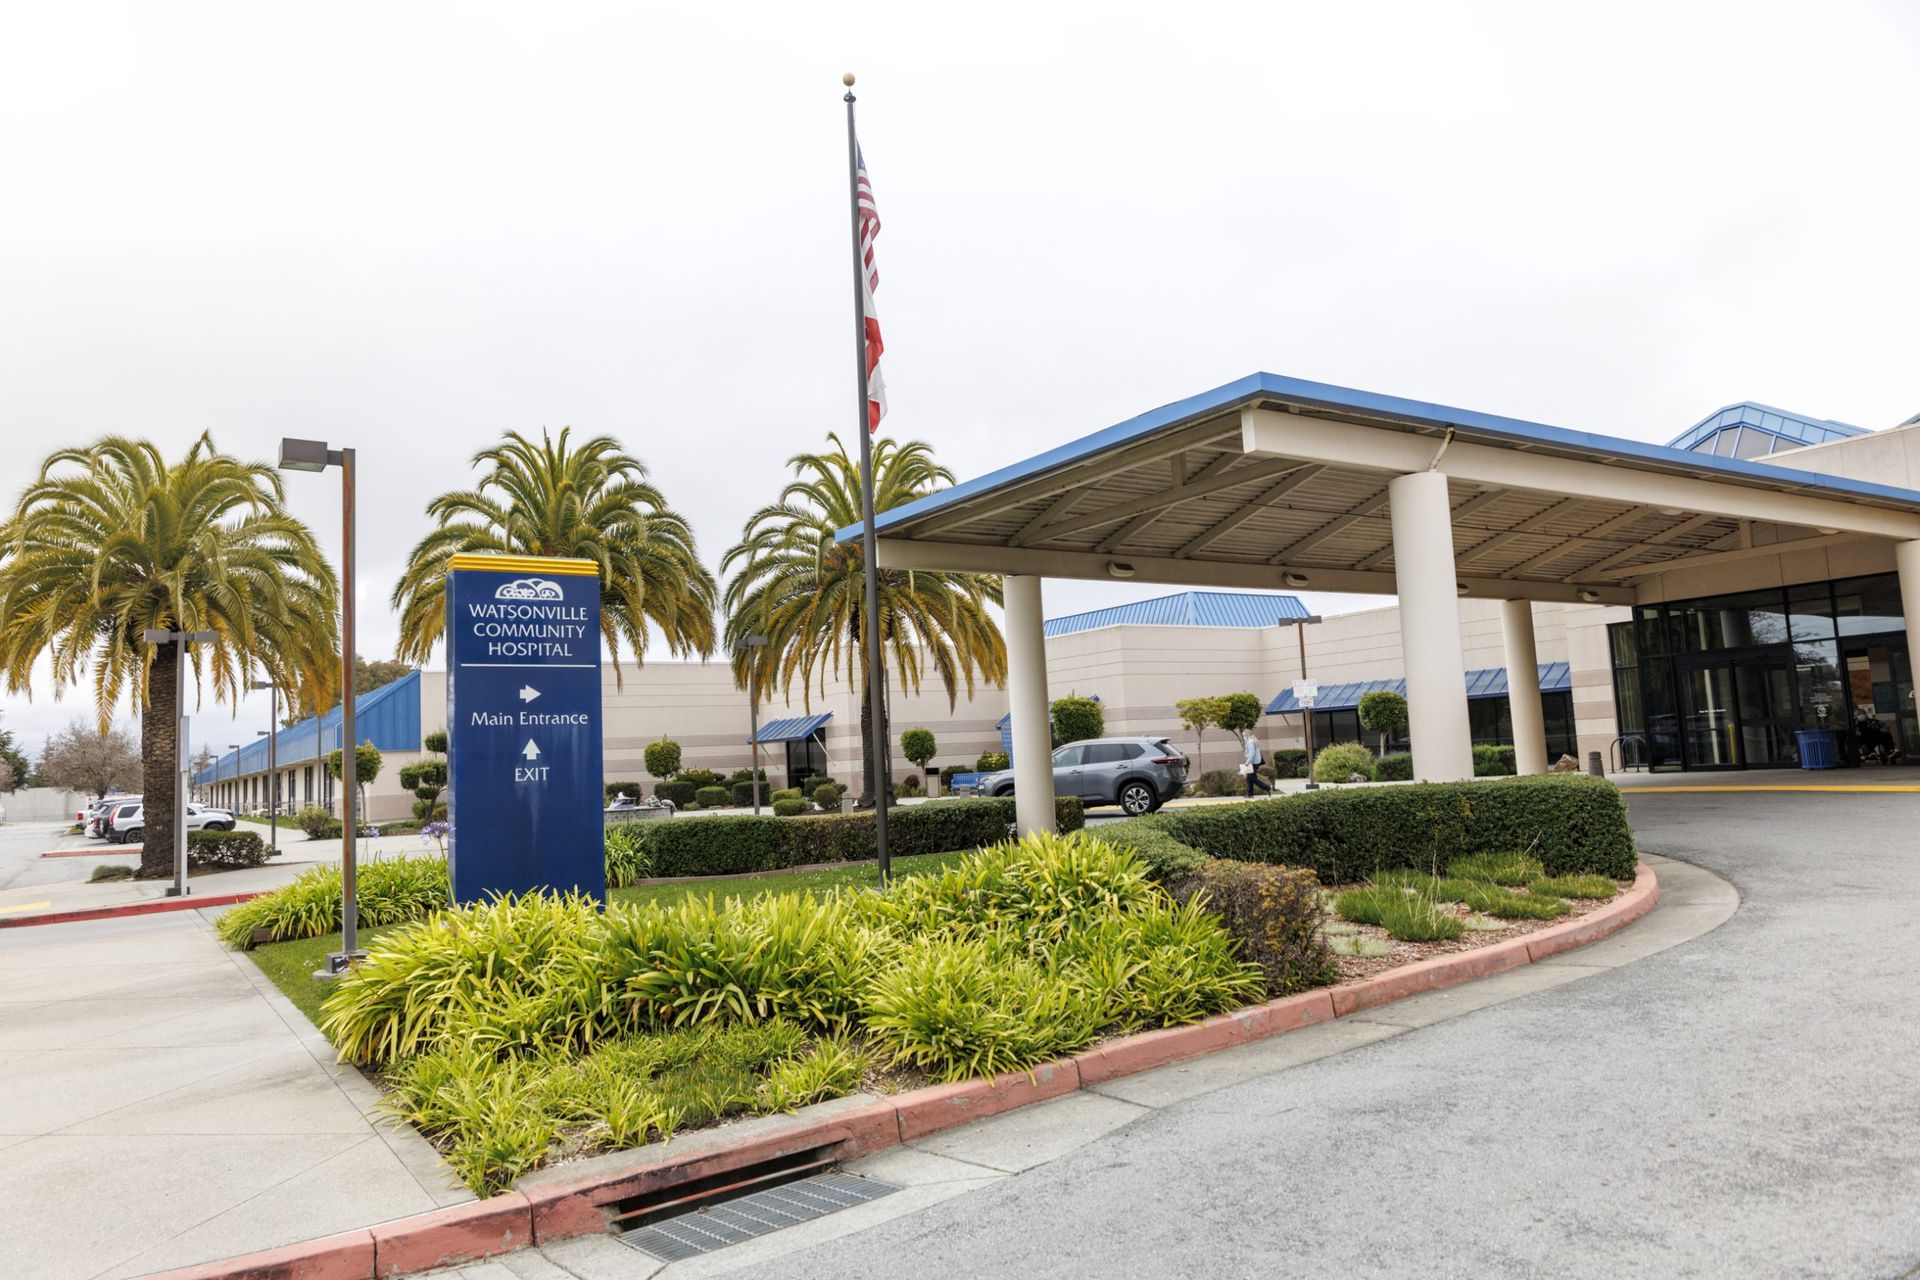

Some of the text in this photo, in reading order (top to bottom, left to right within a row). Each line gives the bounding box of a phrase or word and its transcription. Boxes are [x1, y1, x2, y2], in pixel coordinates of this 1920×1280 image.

[468, 603, 589, 621] WATSONVILLE
[473, 622, 586, 639] COMMUNITY
[488, 641, 573, 657] HOSPITAL
[471, 711, 589, 726] Main Entrance
[515, 766, 550, 782] EXIT
